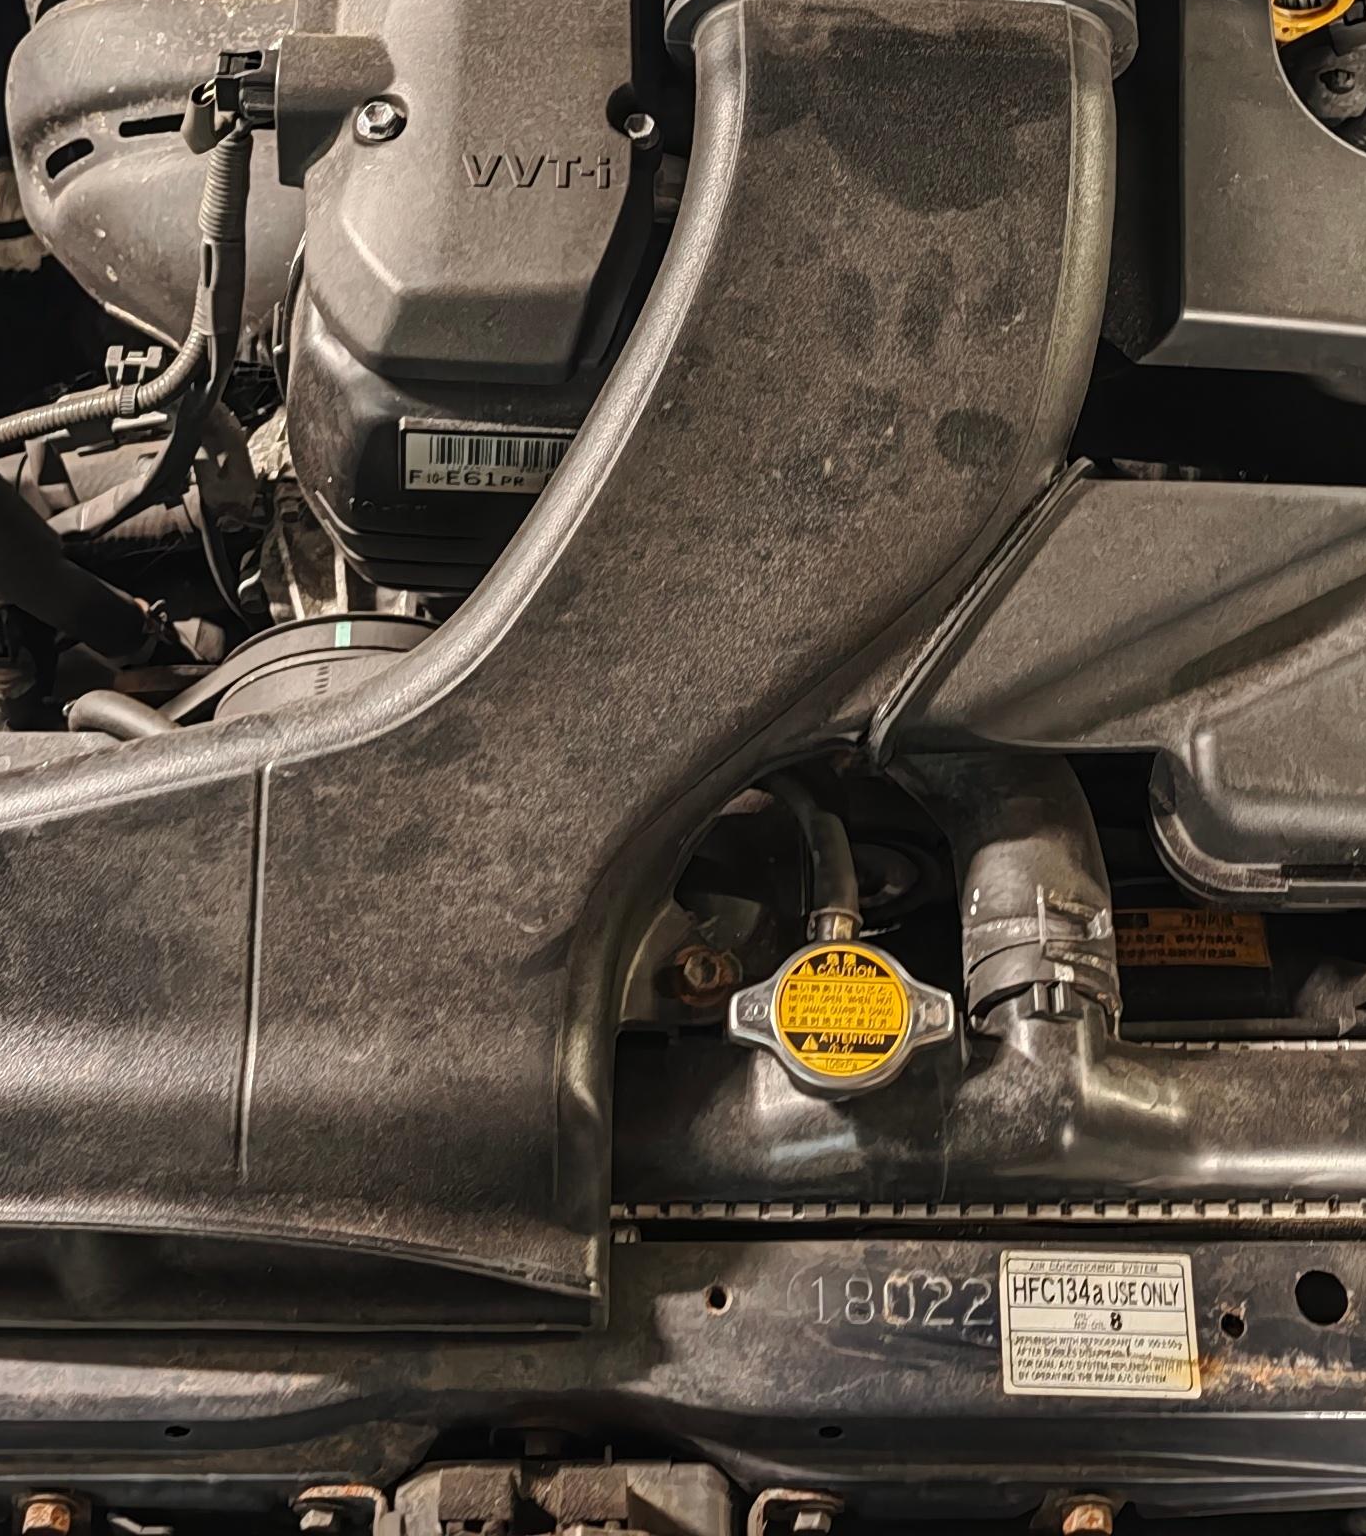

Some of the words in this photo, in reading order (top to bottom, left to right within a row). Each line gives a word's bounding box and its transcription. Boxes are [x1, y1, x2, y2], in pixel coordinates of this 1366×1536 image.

[461, 152, 613, 189] VVT-i
[816, 963, 877, 978] CAUTION
[810, 1271, 995, 1327] 18022
[1012, 1276, 1105, 1306] HFC134a
[1108, 1281, 1138, 1306] USE
[1140, 1281, 1180, 1307] ONLY
[1109, 1311, 1123, 1332] 8
